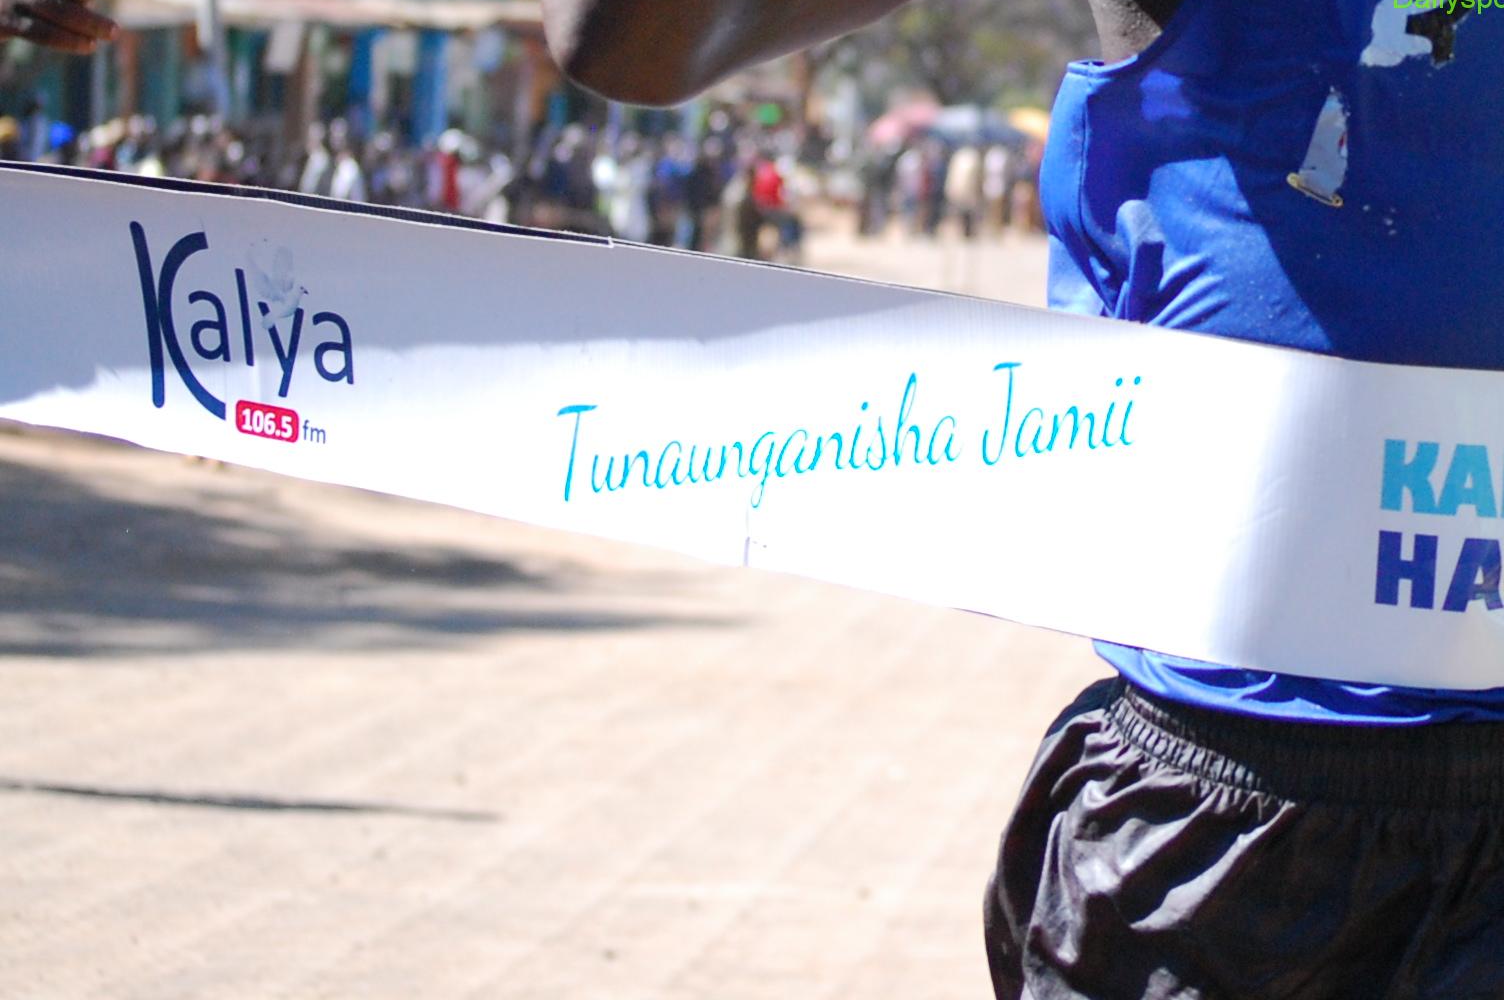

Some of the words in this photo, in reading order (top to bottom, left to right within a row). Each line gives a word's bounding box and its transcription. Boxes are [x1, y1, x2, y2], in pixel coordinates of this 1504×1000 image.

[129, 220, 354, 421] Kalya
[240, 408, 294, 440] 106.5
[302, 419, 327, 444] fm
[556, 371, 961, 509] Tunaunganisha
[982, 361, 1142, 466] Jamii
